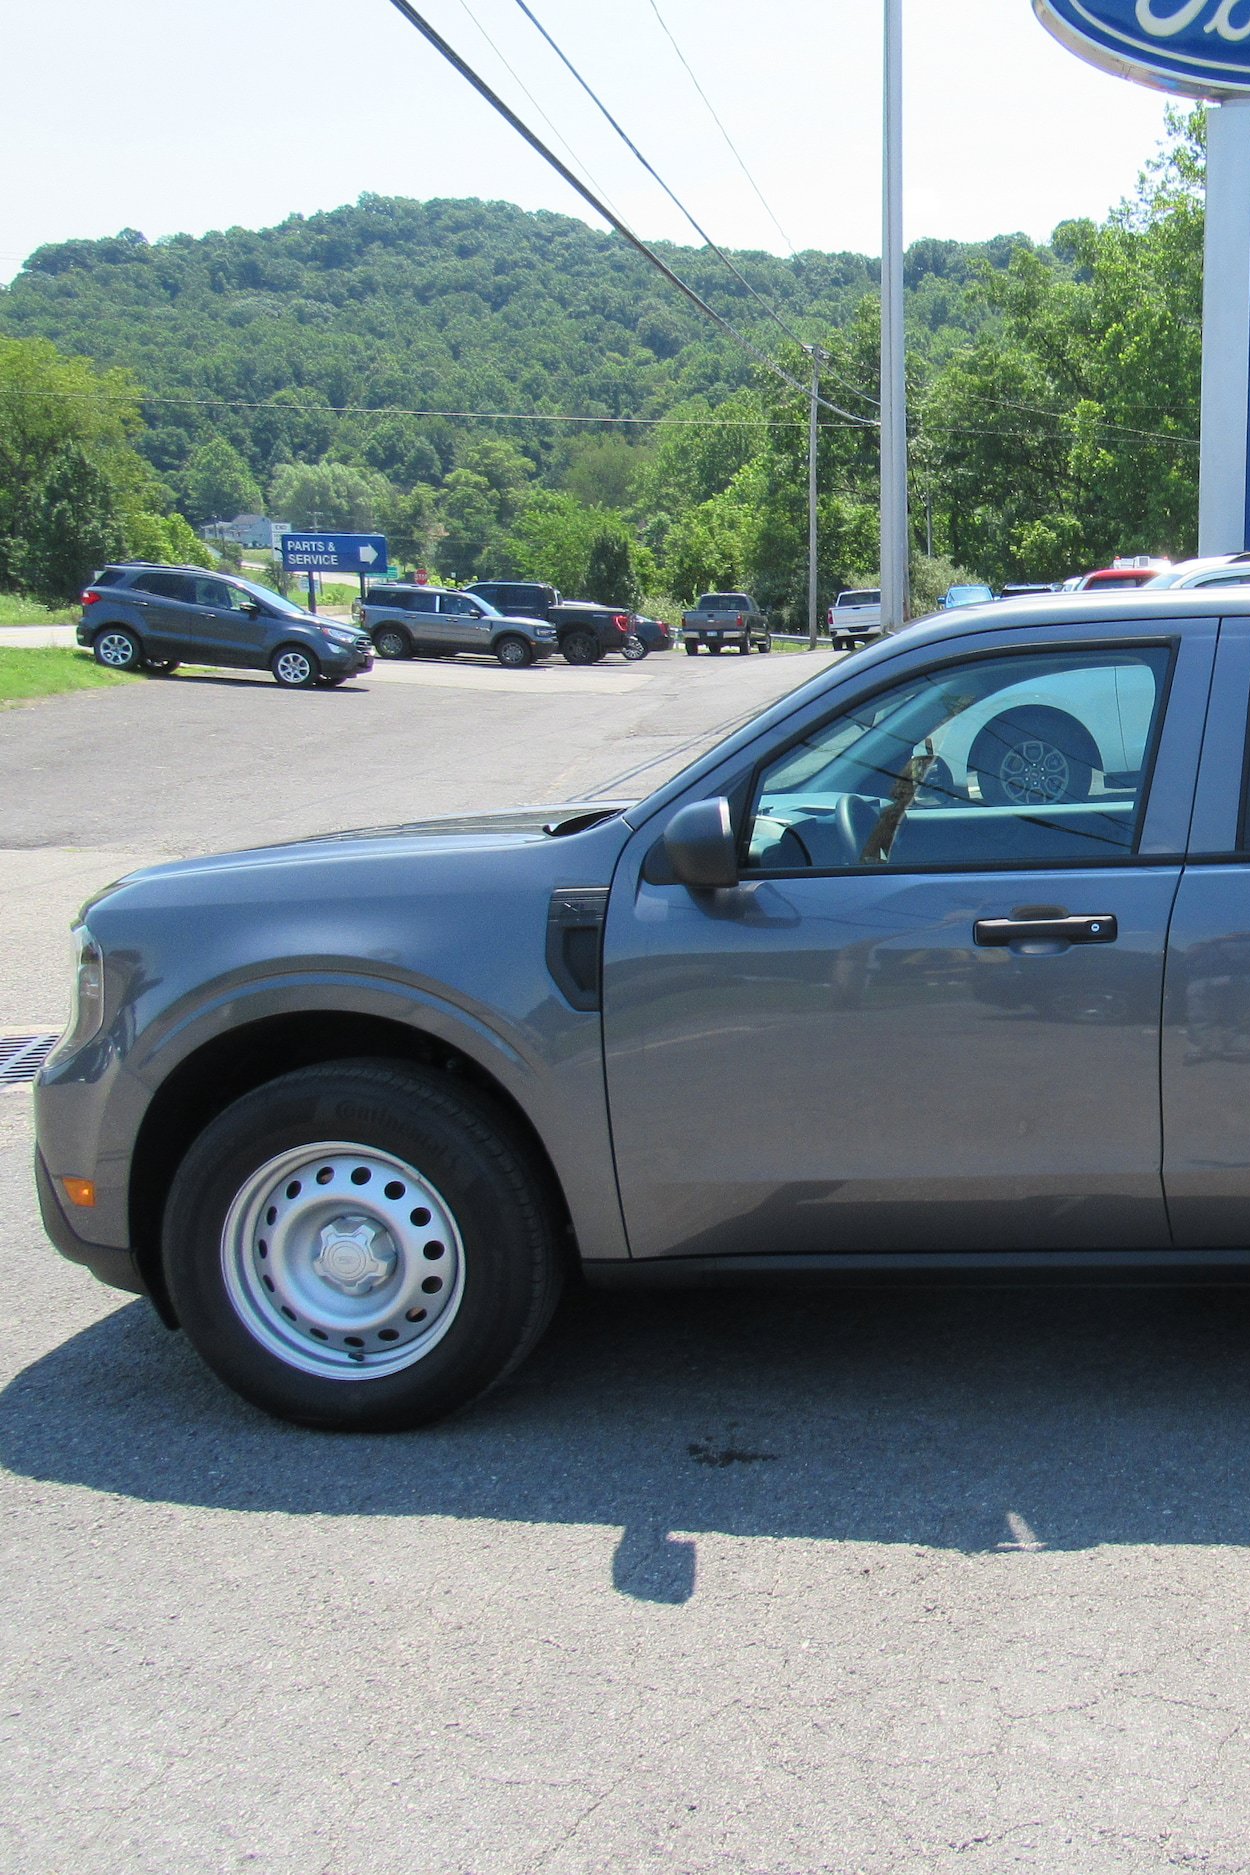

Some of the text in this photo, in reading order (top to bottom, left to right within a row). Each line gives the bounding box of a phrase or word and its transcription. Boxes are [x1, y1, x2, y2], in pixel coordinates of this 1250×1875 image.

[287, 541, 336, 552] PARTS &
[288, 554, 338, 565] SERVICE
